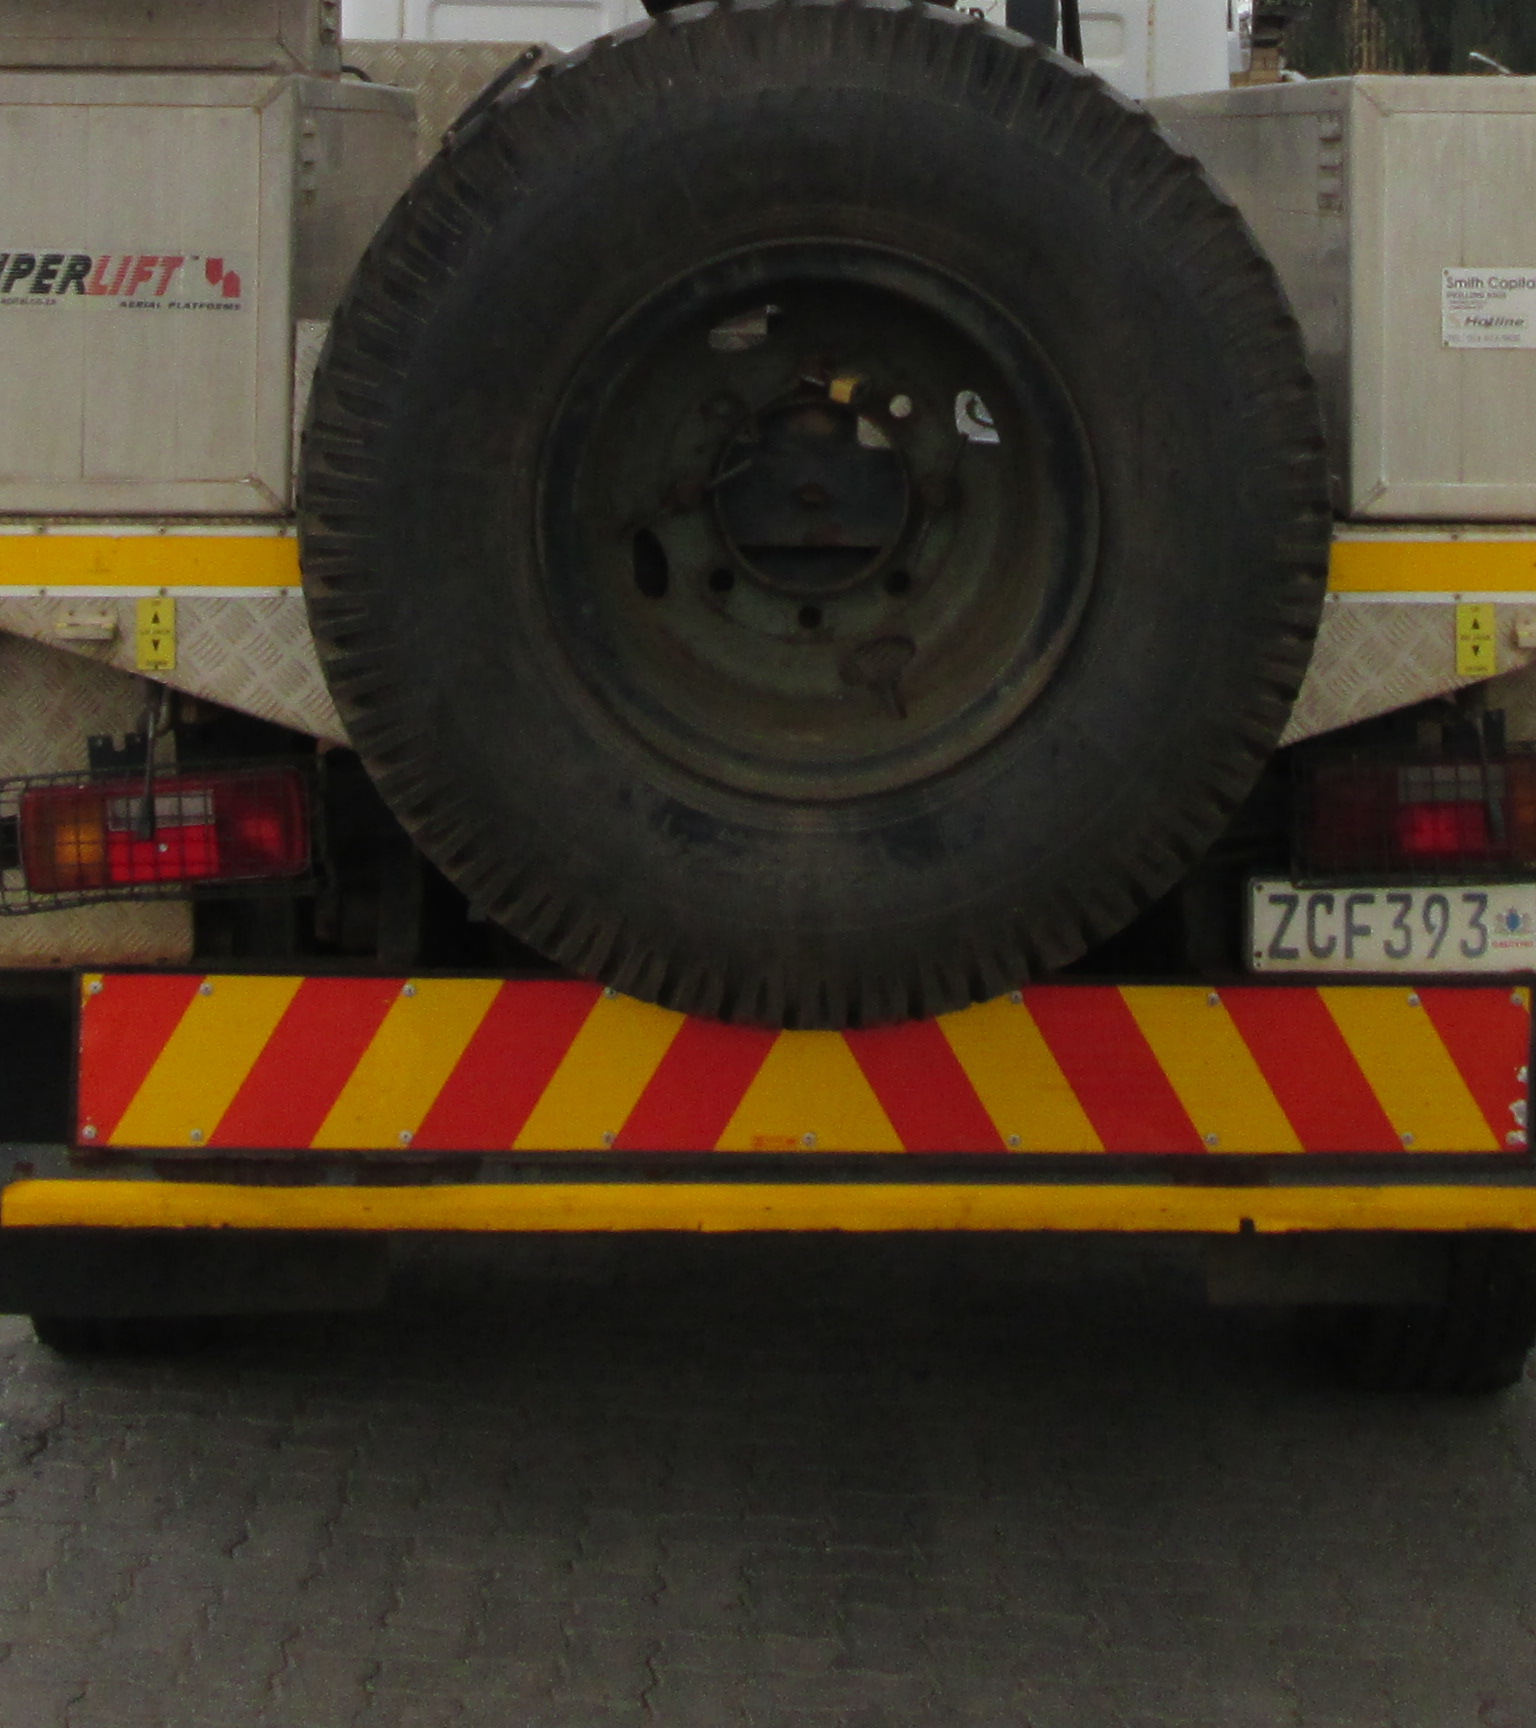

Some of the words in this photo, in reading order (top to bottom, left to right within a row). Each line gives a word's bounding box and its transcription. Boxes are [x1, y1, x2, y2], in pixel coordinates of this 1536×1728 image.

[1446, 276, 1484, 289] Smith
[120, 301, 161, 310] AERIAL
[168, 301, 241, 311] PLATFORMS
[1268, 892, 1489, 960] ZCF393
